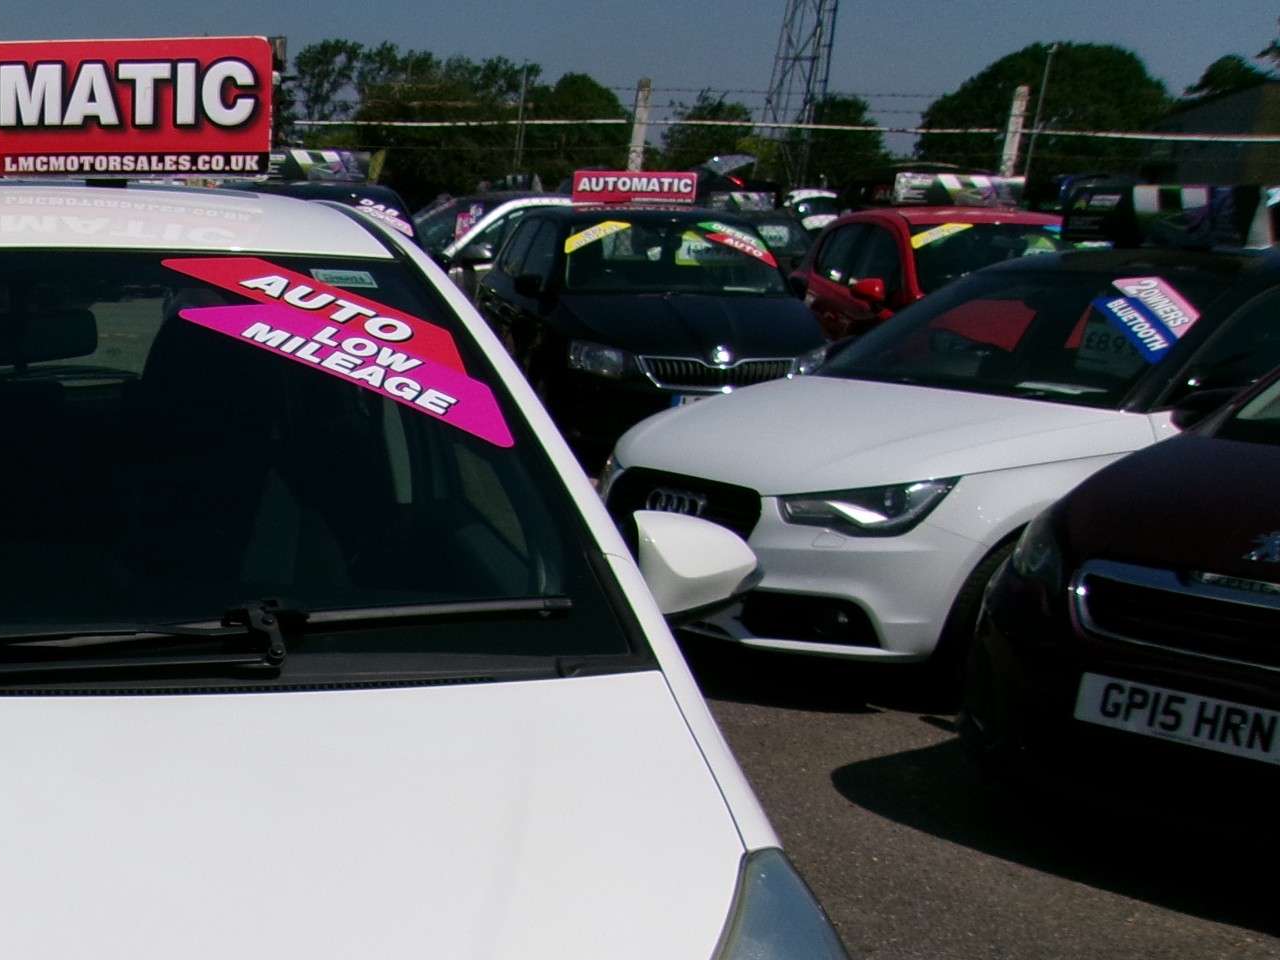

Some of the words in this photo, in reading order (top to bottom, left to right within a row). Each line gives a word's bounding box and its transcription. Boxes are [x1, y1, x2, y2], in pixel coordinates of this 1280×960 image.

[4, 154, 259, 173] LMCMOTORSALES.CO.UK
[577, 176, 693, 194] AUTOMATIC
[723, 237, 764, 258] AUTO
[238, 274, 414, 342] AUTO
[1106, 298, 1170, 352] BLUETOOTH
[1141, 284, 1191, 328] OWNERS
[240, 321, 459, 416] MILEAGE
[311, 325, 423, 374] LOW
[1099, 682, 1187, 732] GP15
[1193, 701, 1278, 753] HRN
